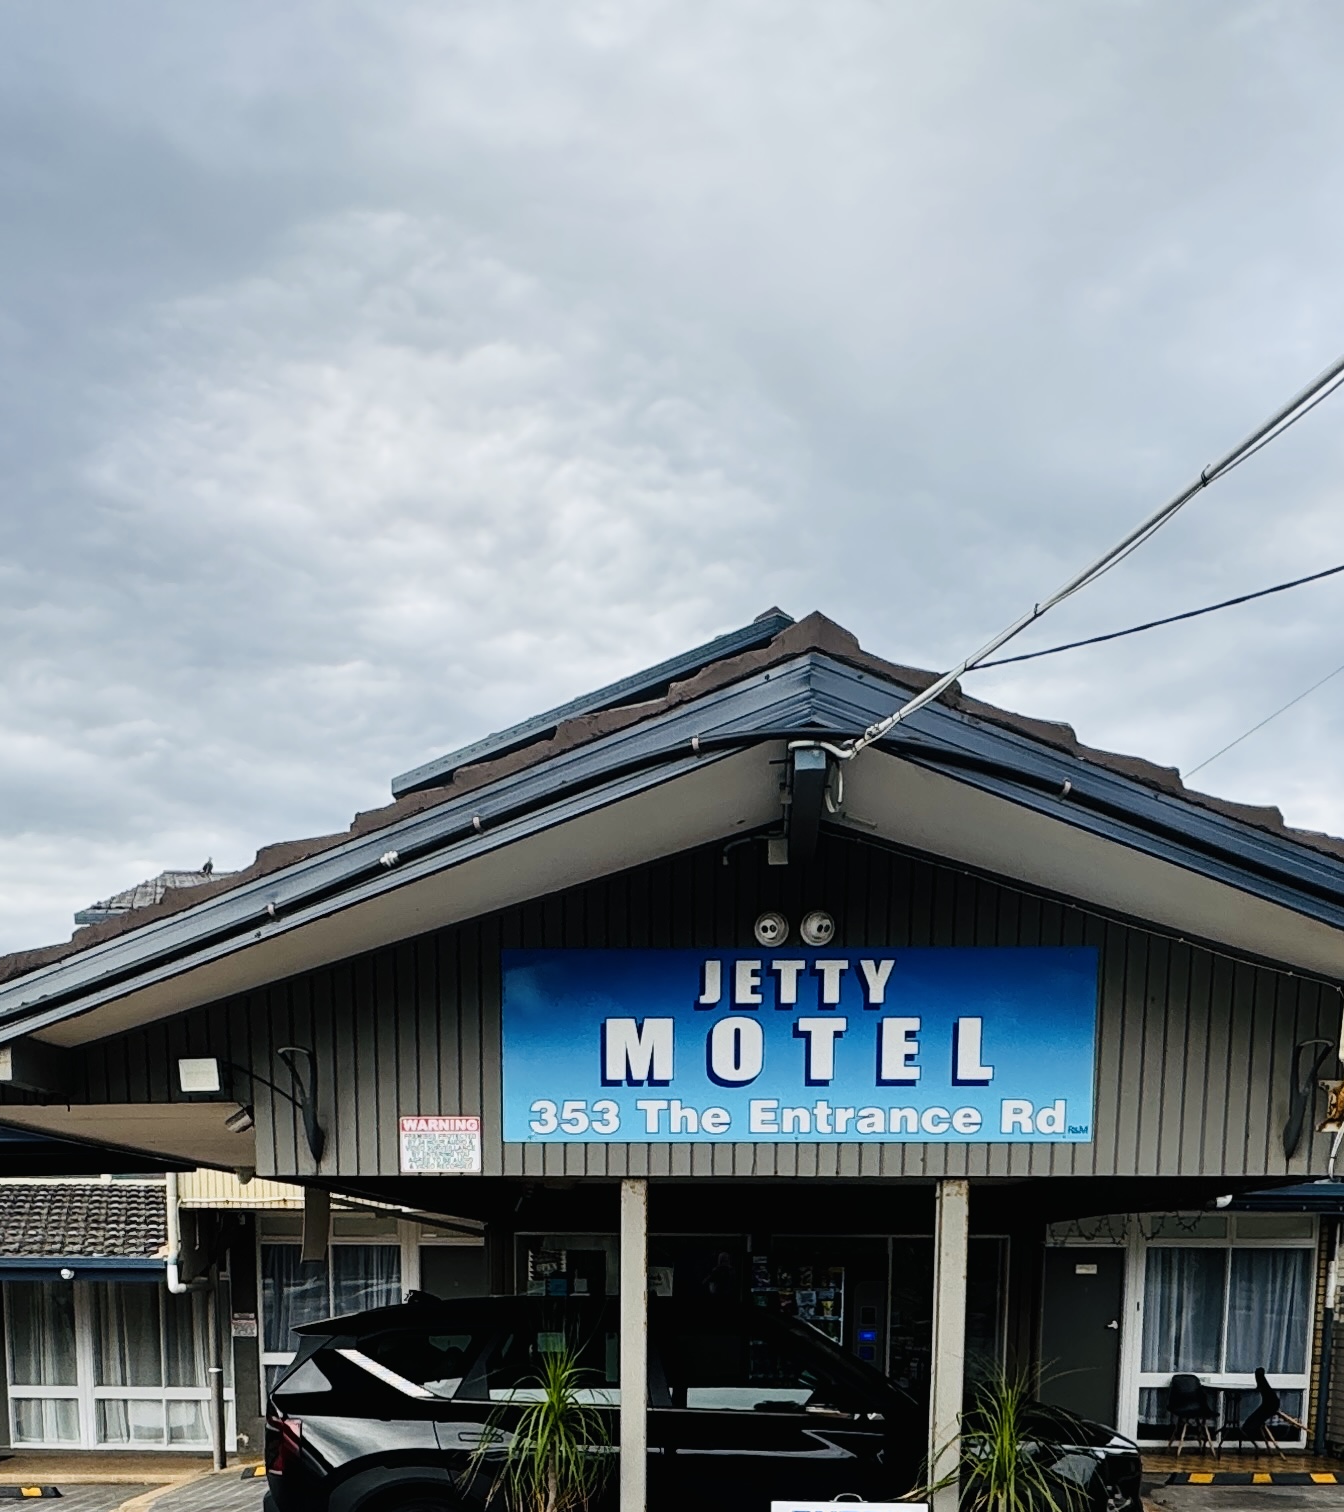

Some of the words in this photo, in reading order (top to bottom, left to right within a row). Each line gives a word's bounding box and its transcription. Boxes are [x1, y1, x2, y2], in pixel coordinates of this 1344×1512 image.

[694, 958, 896, 1009] JETTY
[602, 1015, 996, 1086] MOTEL
[403, 1119, 479, 1131] WARNING
[529, 1099, 622, 1135] 353
[635, 1098, 732, 1135] The
[747, 1099, 983, 1135] Entrance
[999, 1099, 1067, 1135] Rd
